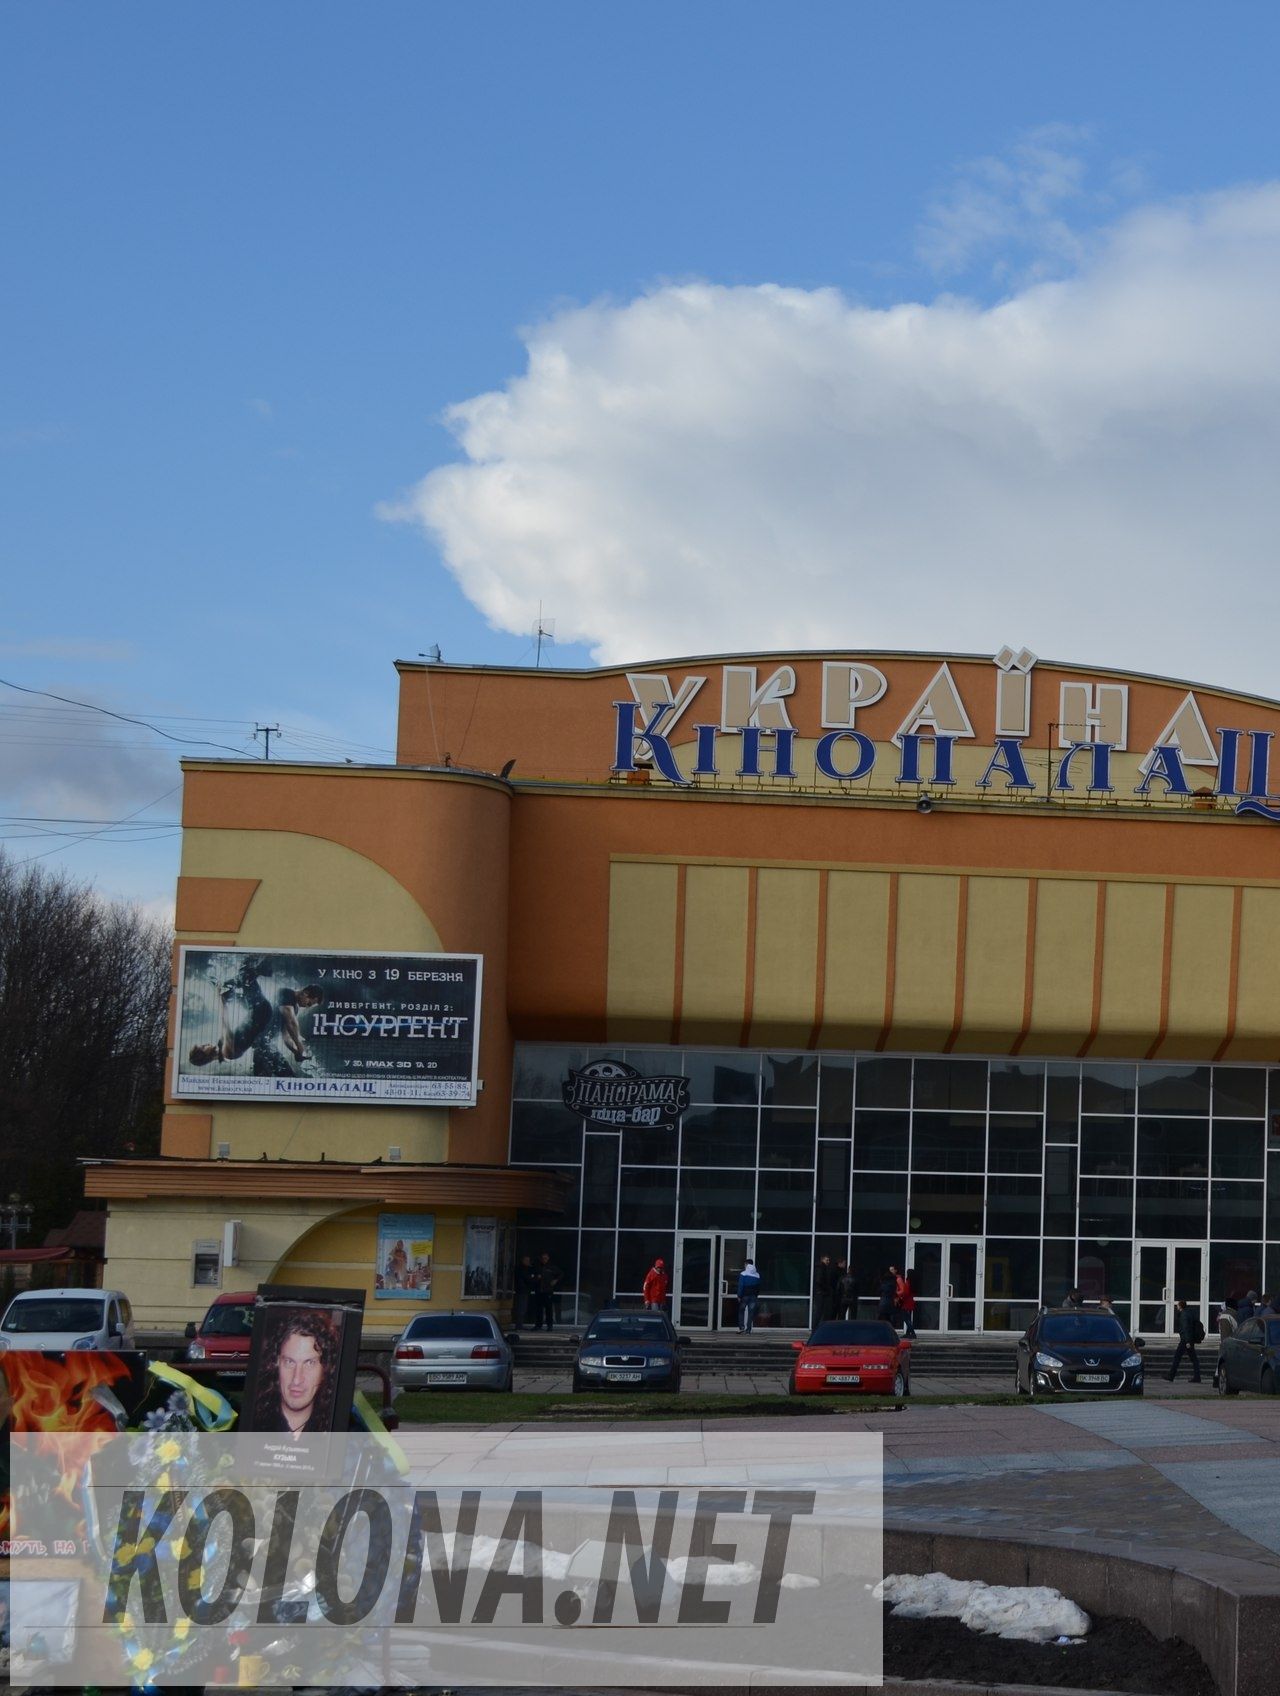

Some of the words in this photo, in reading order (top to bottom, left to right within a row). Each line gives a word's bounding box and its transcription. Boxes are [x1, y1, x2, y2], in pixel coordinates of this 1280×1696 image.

[318, 968, 327, 979] У
[332, 969, 363, 980] КІНО
[384, 968, 400, 981] 19
[407, 971, 464, 983] БЕРЕЗНЯ
[401, 1003, 441, 1012] РОЗДІЛ
[312, 1013, 469, 1039] ІНСУРГЕНТ
[365, 1060, 395, 1068] IMAX
[396, 1061, 412, 1069] 3D
[275, 1079, 376, 1095] КІНОПАЛАЦ
[578, 1082, 676, 1103] ПАНОРАМА
